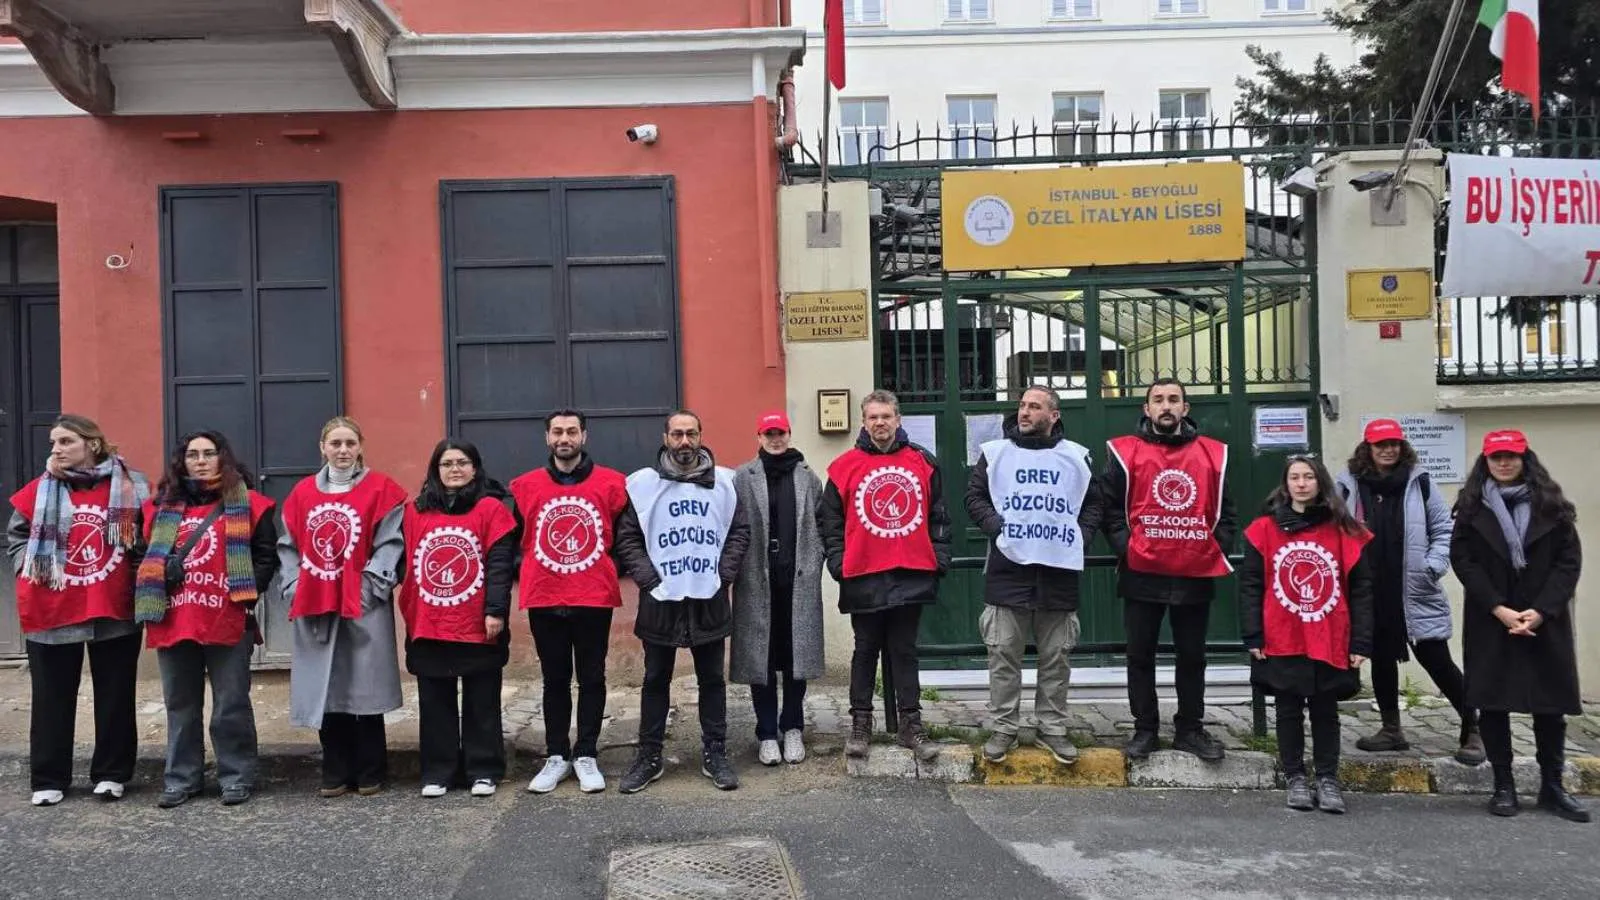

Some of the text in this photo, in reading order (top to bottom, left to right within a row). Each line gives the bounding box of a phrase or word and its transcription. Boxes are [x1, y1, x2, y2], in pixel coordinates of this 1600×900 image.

[1049, 187, 1119, 202] İSTANBUL
[1466, 176, 1501, 224] BU
[1027, 206, 1074, 226] ÖZEL
[1081, 204, 1157, 224] İTALYAN
[1165, 198, 1221, 219] LİSESİ
[1189, 223, 1222, 236] 1888
[1582, 250, 1600, 285] T
[789, 314, 818, 325] ÖZEL
[812, 326, 843, 336] LİSESİ
[1016, 468, 1060, 485] GREV
[669, 499, 710, 518] GREV
[1145, 527, 1208, 540] SENDİKASI
